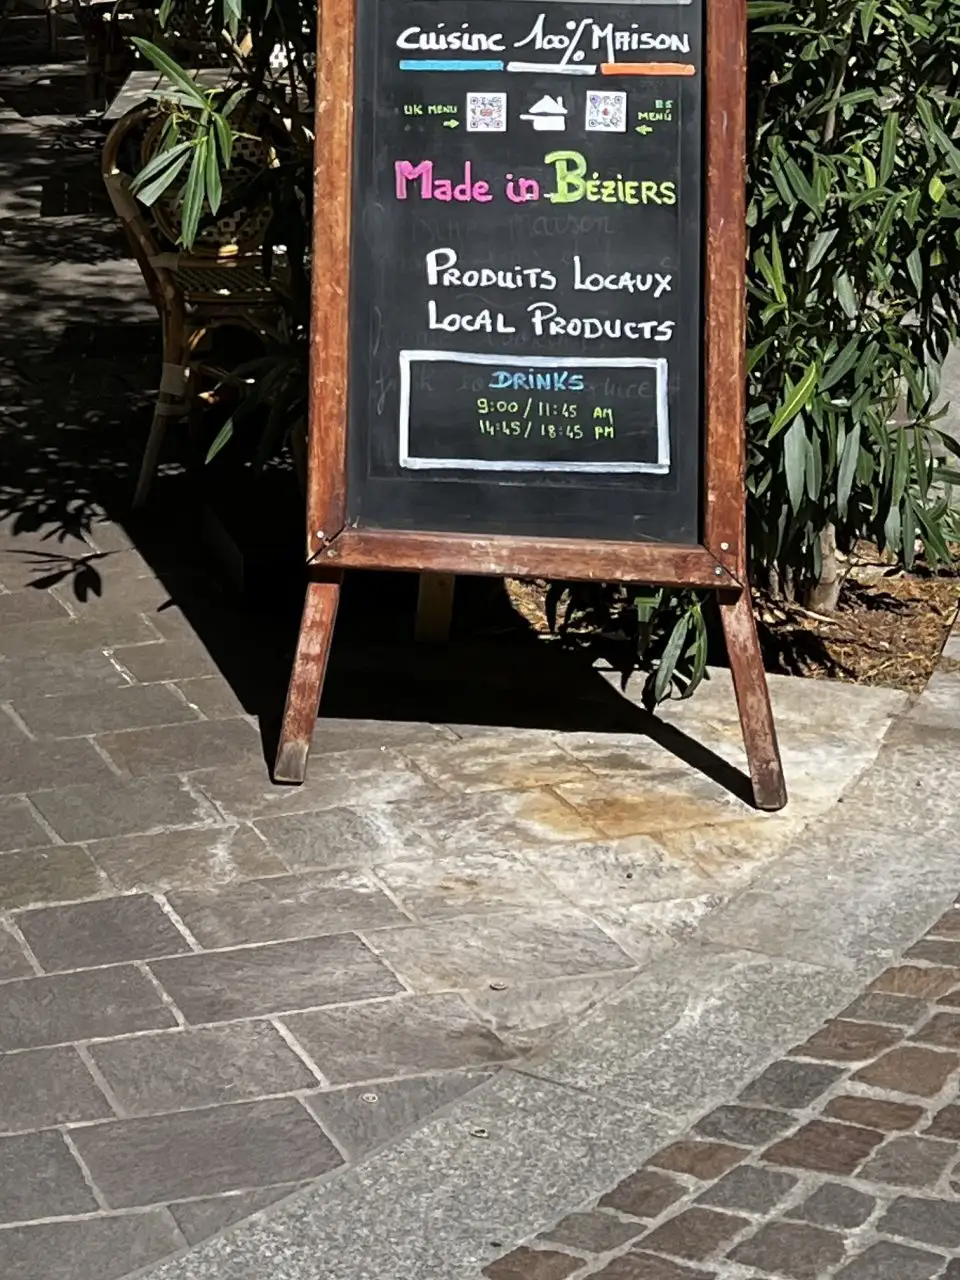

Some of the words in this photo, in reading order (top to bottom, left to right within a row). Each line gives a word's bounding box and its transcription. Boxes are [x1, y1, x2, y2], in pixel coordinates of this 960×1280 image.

[513, 13, 593, 65] 100%
[403, 104, 423, 115] UK
[427, 104, 458, 115] MENU
[395, 160, 493, 202] Made
[505, 173, 540, 203] in
[573, 255, 673, 298] LOCAUX
[428, 300, 516, 333] LOCAL
[527, 301, 676, 341] PRODUCTS
[488, 368, 585, 391] DRINKS
[593, 406, 613, 424] AM
[594, 425, 614, 440] PM
